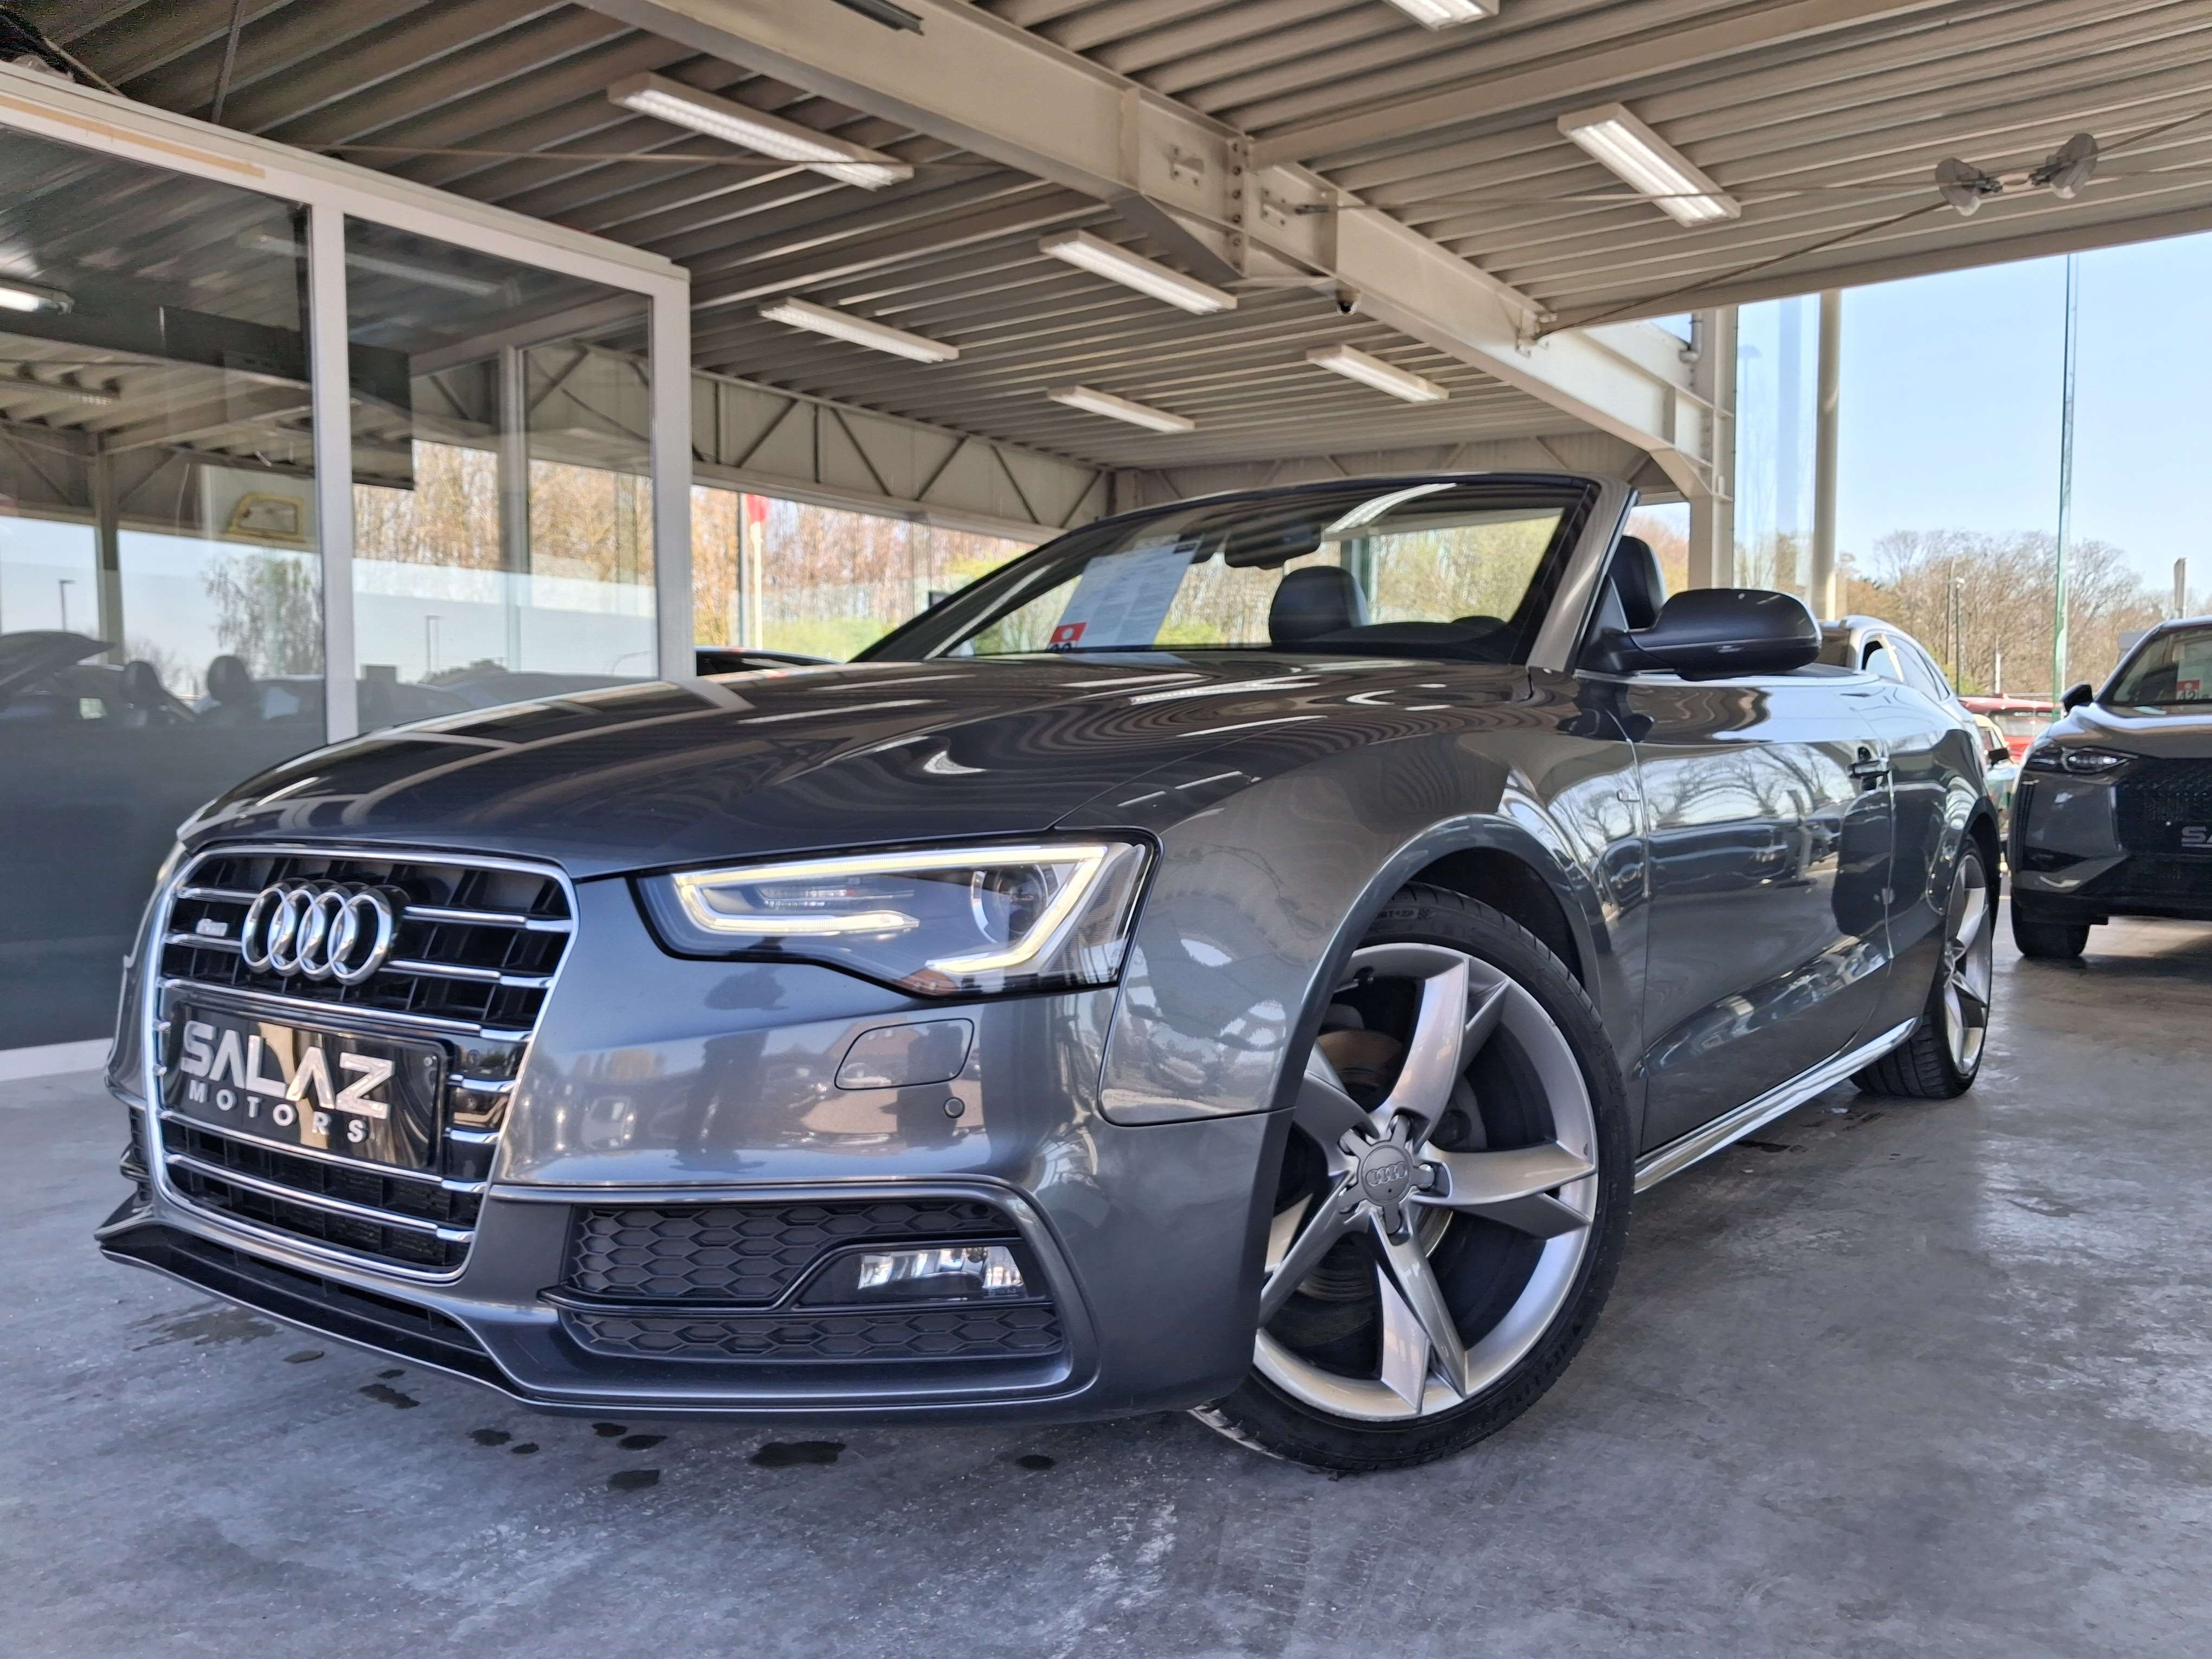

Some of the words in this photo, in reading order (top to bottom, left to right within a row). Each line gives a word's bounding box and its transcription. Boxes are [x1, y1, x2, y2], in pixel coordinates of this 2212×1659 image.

[2182, 826, 2212, 843] S
[181, 1020, 395, 1120] SALAZ
[189, 1079, 368, 1143] MOTORS
